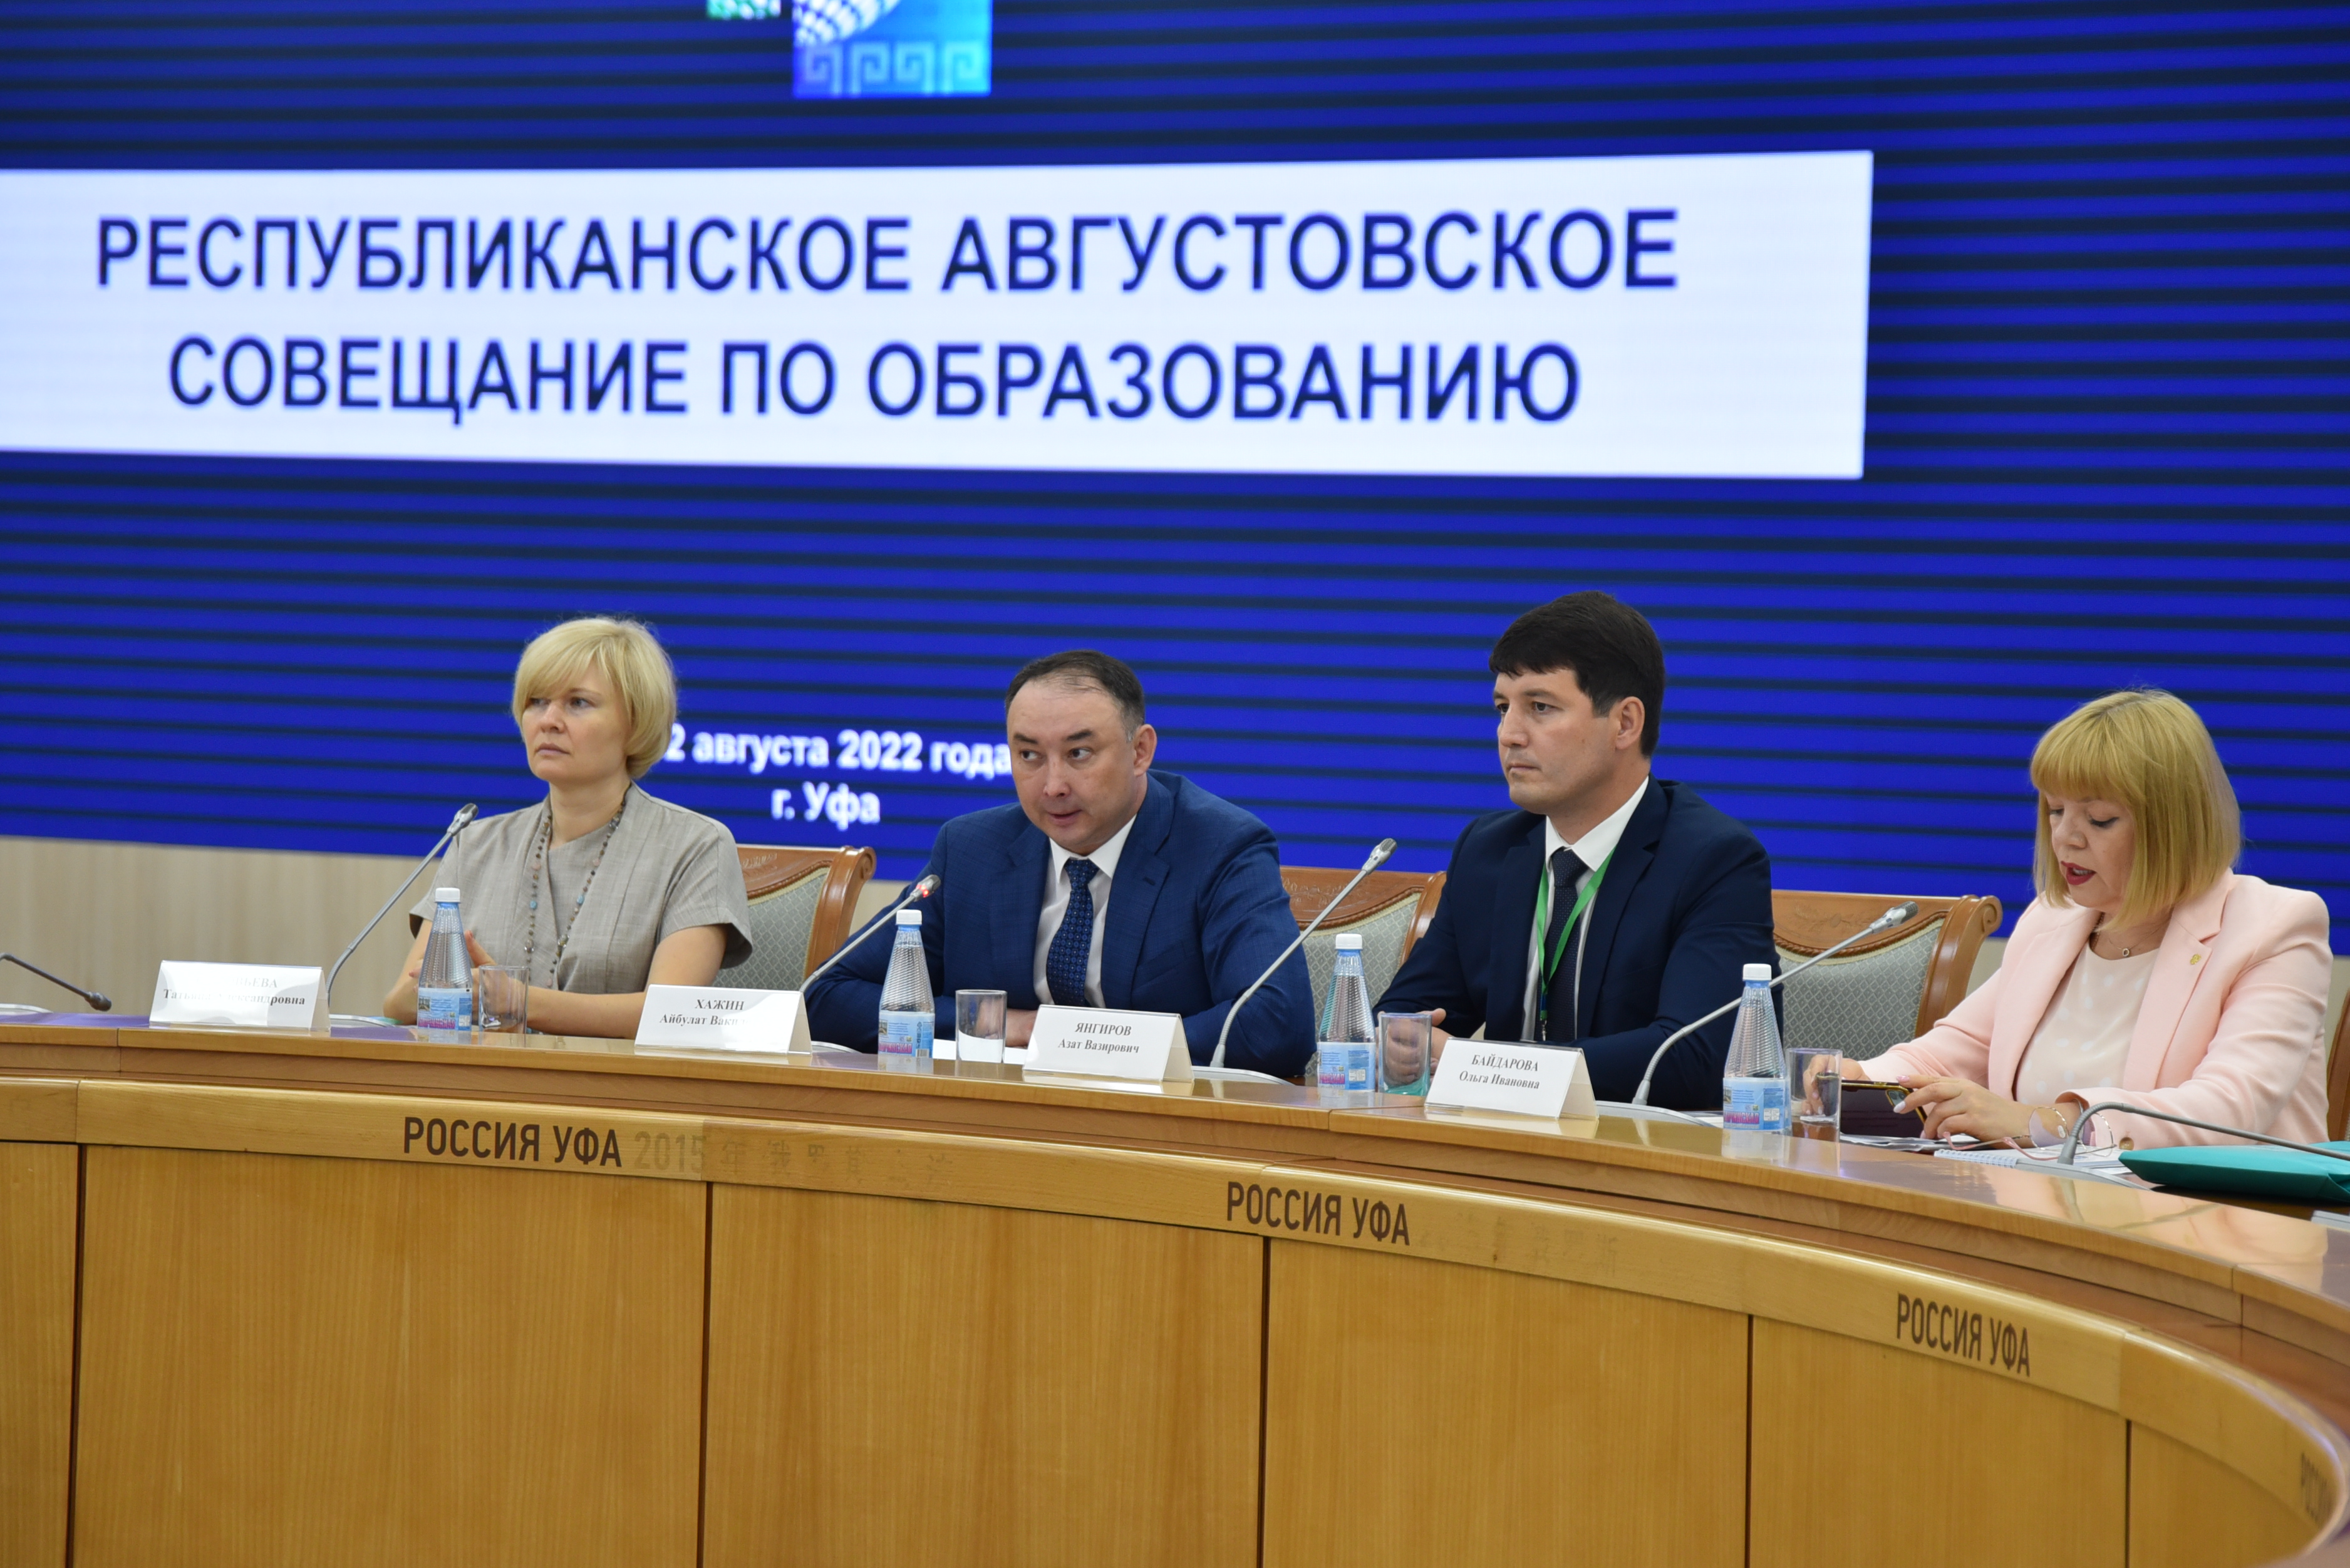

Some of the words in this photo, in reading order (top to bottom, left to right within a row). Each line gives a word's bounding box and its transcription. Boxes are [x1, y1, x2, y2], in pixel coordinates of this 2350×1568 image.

[98, 217, 911, 293] РЕСПУБЛИКАНСКОЕ
[939, 209, 1677, 293] АВГУСТОВСКОЕ
[168, 336, 688, 426] СОВЕЩАНИЕ
[721, 341, 837, 416] ПО
[866, 342, 1580, 423] ОБРАЗОВАНИЮ
[692, 731, 830, 774] августа
[837, 729, 923, 771] 2022
[930, 741, 1012, 780] года
[771, 788, 796, 820] г.
[802, 781, 881, 831] Уфа
[219, 993, 306, 1006] ександровна
[695, 999, 745, 1011] ХАЖИН
[659, 1013, 708, 1027] Айбулат
[1074, 1022, 1132, 1036] ЯНГИРОВ
[1057, 1038, 1083, 1050] Азат
[1084, 1039, 1140, 1055] Вазирович
[1471, 1053, 1540, 1073] БАЙДАРОВА
[1459, 1070, 1489, 1085] Ольга
[1490, 1073, 1541, 1090] Ивановна
[403, 1117, 541, 1162] РОССИЯ
[552, 1126, 622, 1167] УФА
[1227, 1181, 1343, 1237] РОССИЯ
[1352, 1197, 1411, 1246] УФА
[1897, 1292, 1983, 1361] РОССИЯ
[1989, 1318, 2031, 1377] УФА
